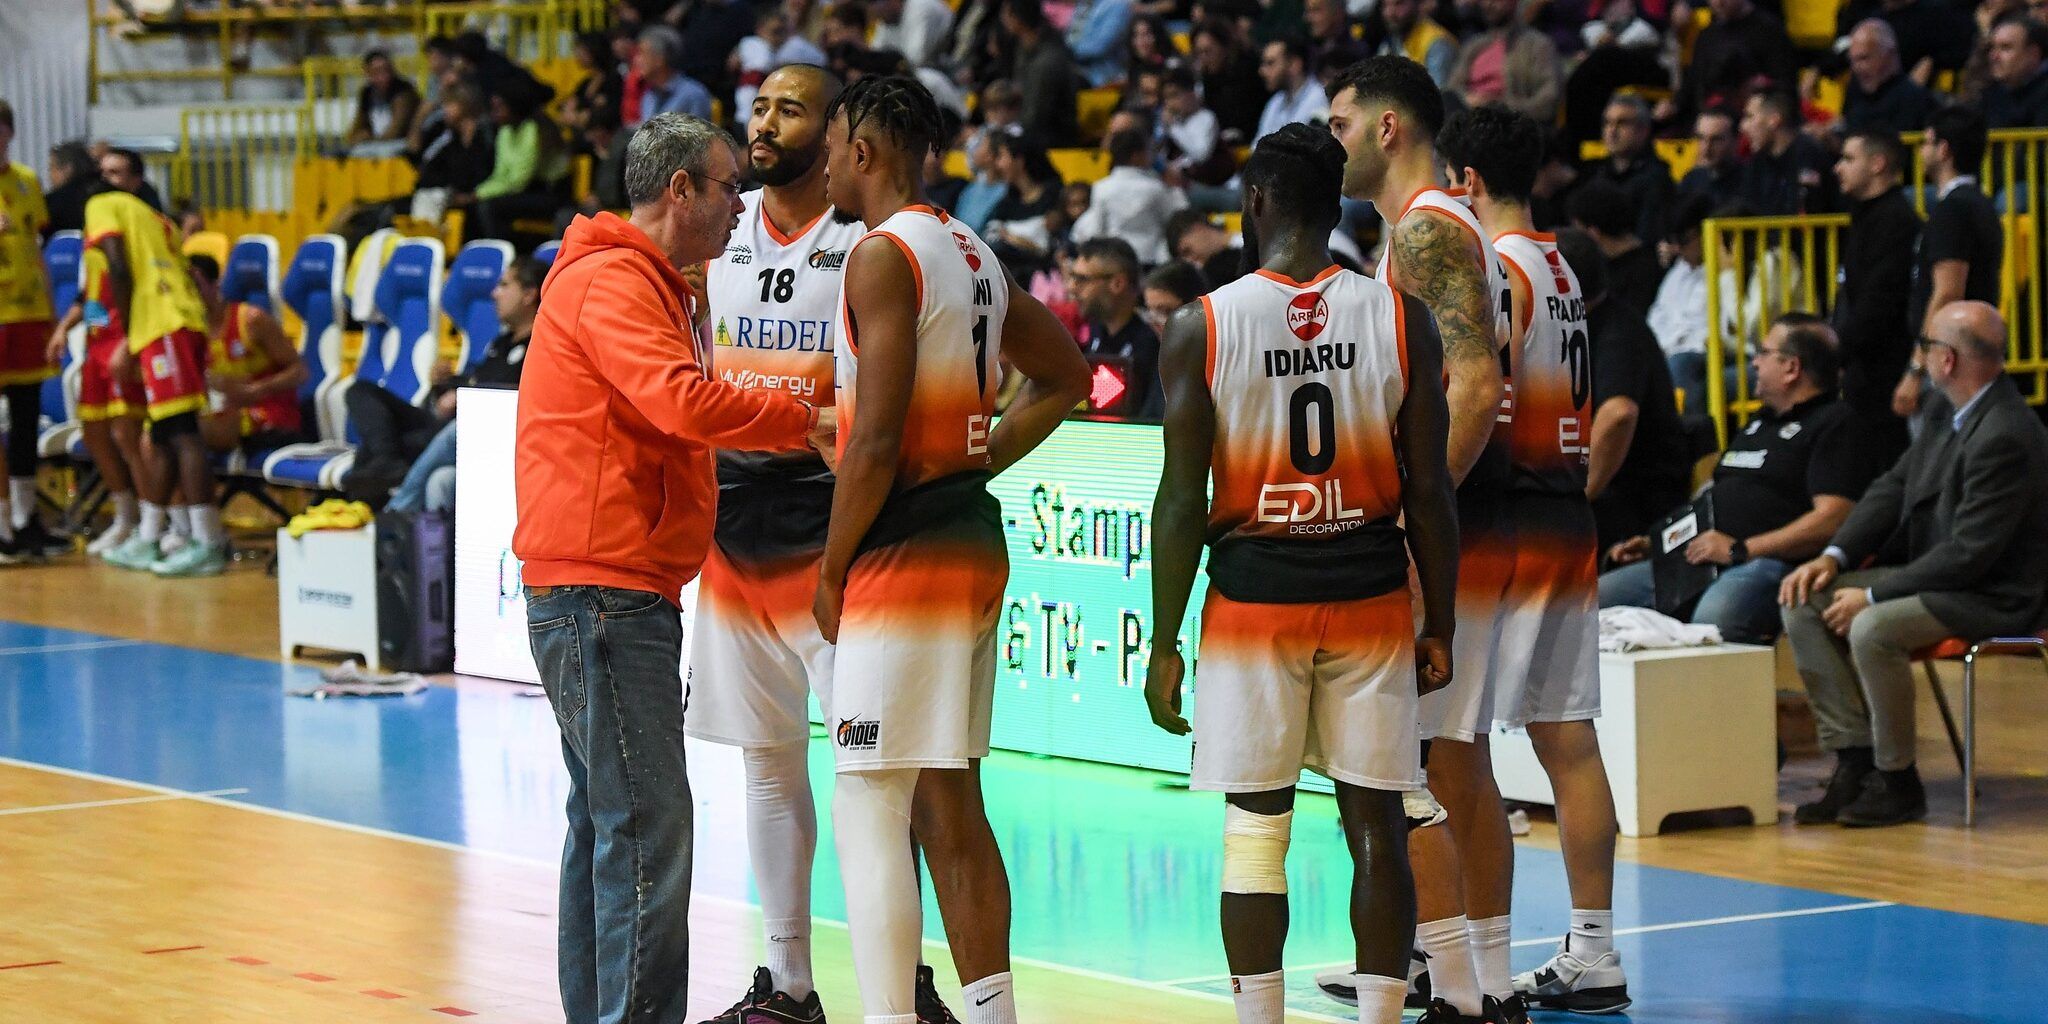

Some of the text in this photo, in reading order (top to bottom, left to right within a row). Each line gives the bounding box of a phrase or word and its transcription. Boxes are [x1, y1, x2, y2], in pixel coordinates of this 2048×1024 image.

[731, 254, 752, 265] GECO
[758, 268, 795, 303] 18
[736, 316, 834, 353] REDEL
[1264, 343, 1355, 377] IDIARU
[1289, 382, 1336, 475] 0
[1258, 478, 1364, 522] EDIL
[1289, 520, 1365, 534] DECORATION
[844, 724, 879, 746] VIOLA
